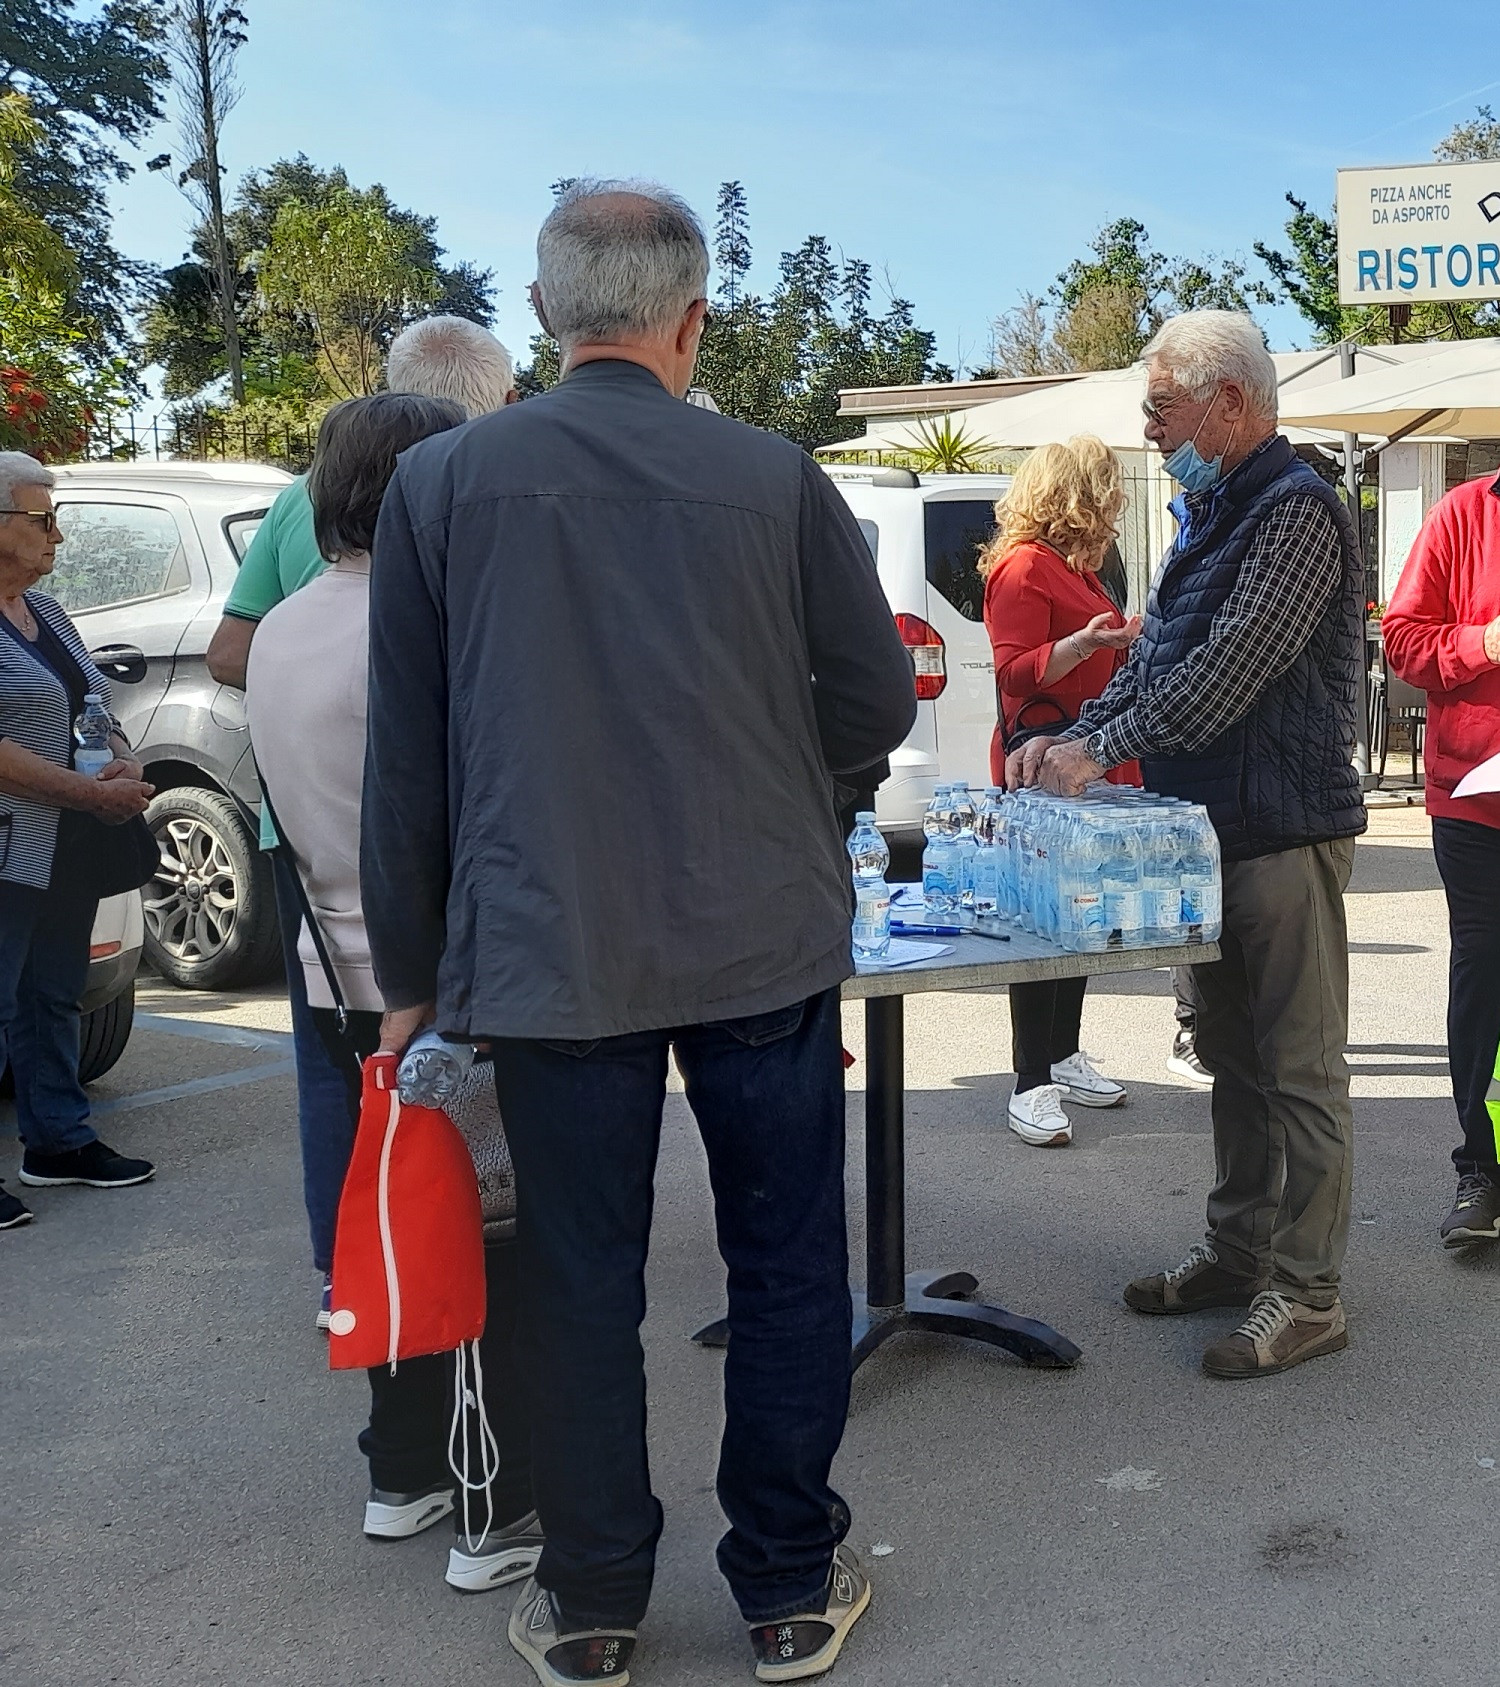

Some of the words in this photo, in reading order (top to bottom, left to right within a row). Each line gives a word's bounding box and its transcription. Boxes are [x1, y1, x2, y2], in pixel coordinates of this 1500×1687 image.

[1370, 186, 1405, 204] PIZZA
[1408, 183, 1452, 202] ANCHE
[1372, 208, 1389, 225] DA
[1392, 204, 1450, 223] ASPORTO
